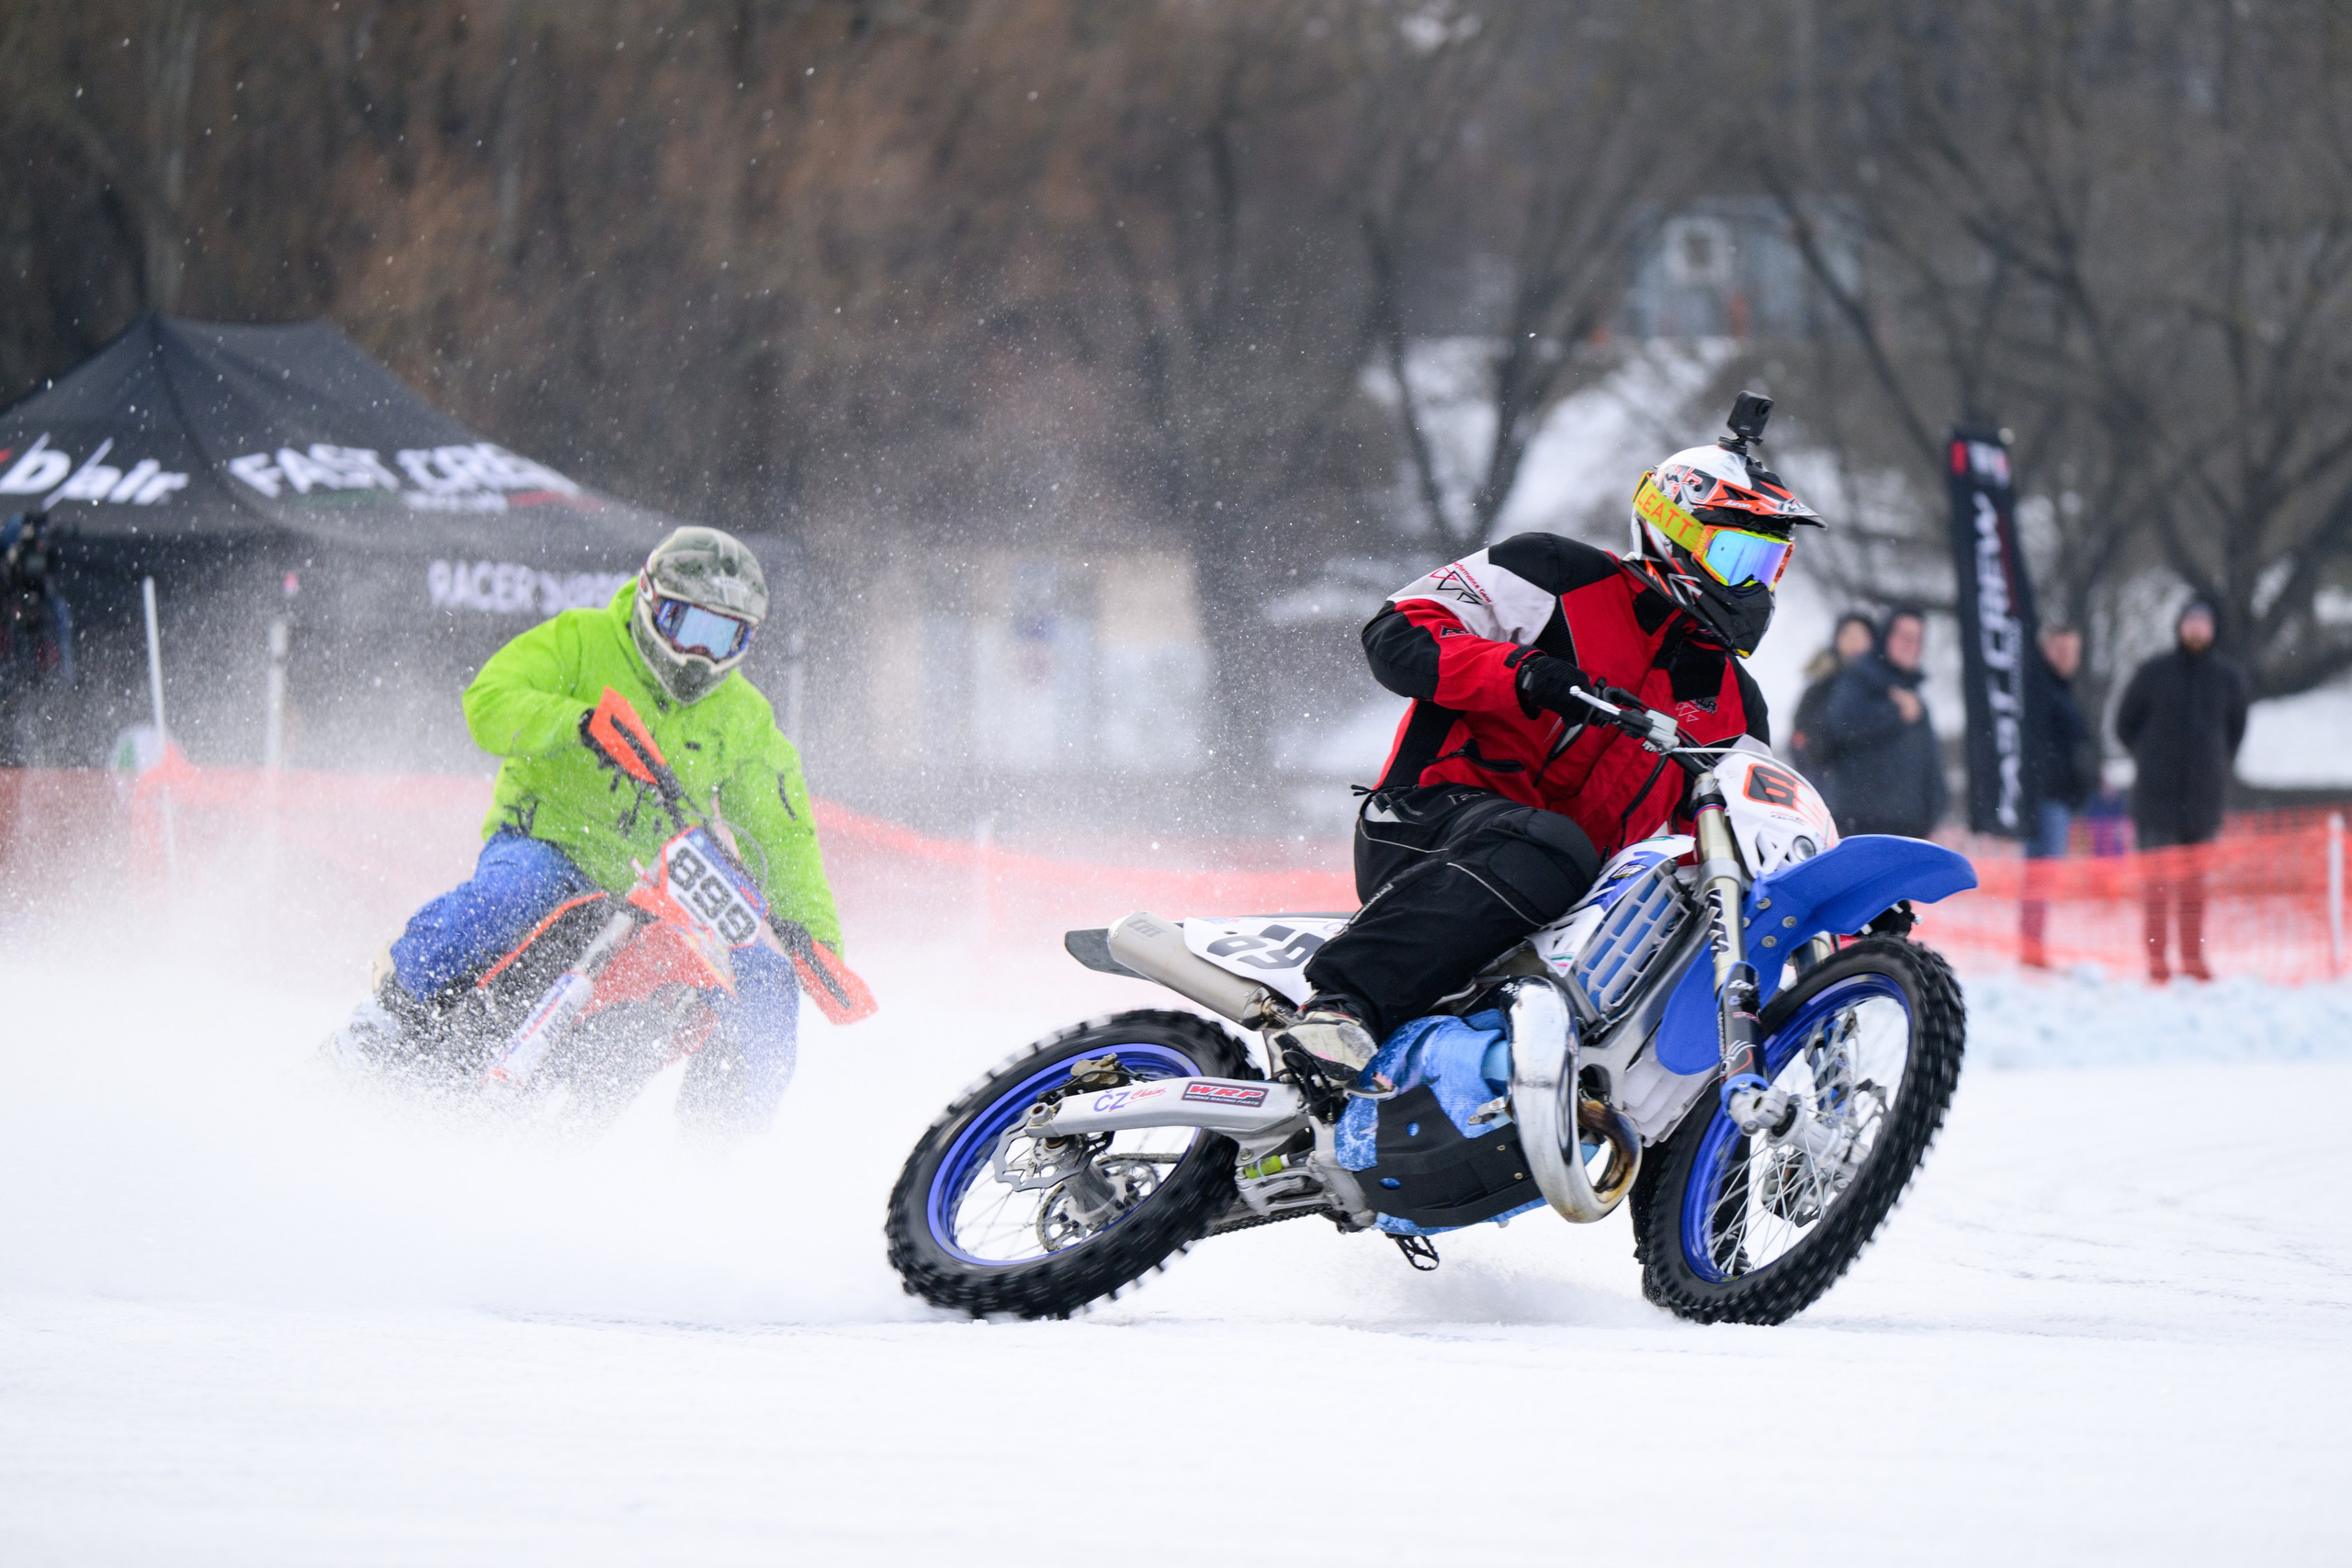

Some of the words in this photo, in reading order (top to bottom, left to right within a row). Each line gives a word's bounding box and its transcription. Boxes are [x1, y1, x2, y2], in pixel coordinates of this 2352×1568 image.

[1636, 485, 1694, 538] LEATT
[1453, 561, 1480, 590] erformance
[1478, 588, 1492, 604] Gear
[667, 846, 757, 944] 899
[1093, 1089, 1132, 1112] ČZ
[1188, 1085, 1263, 1100] WRP
